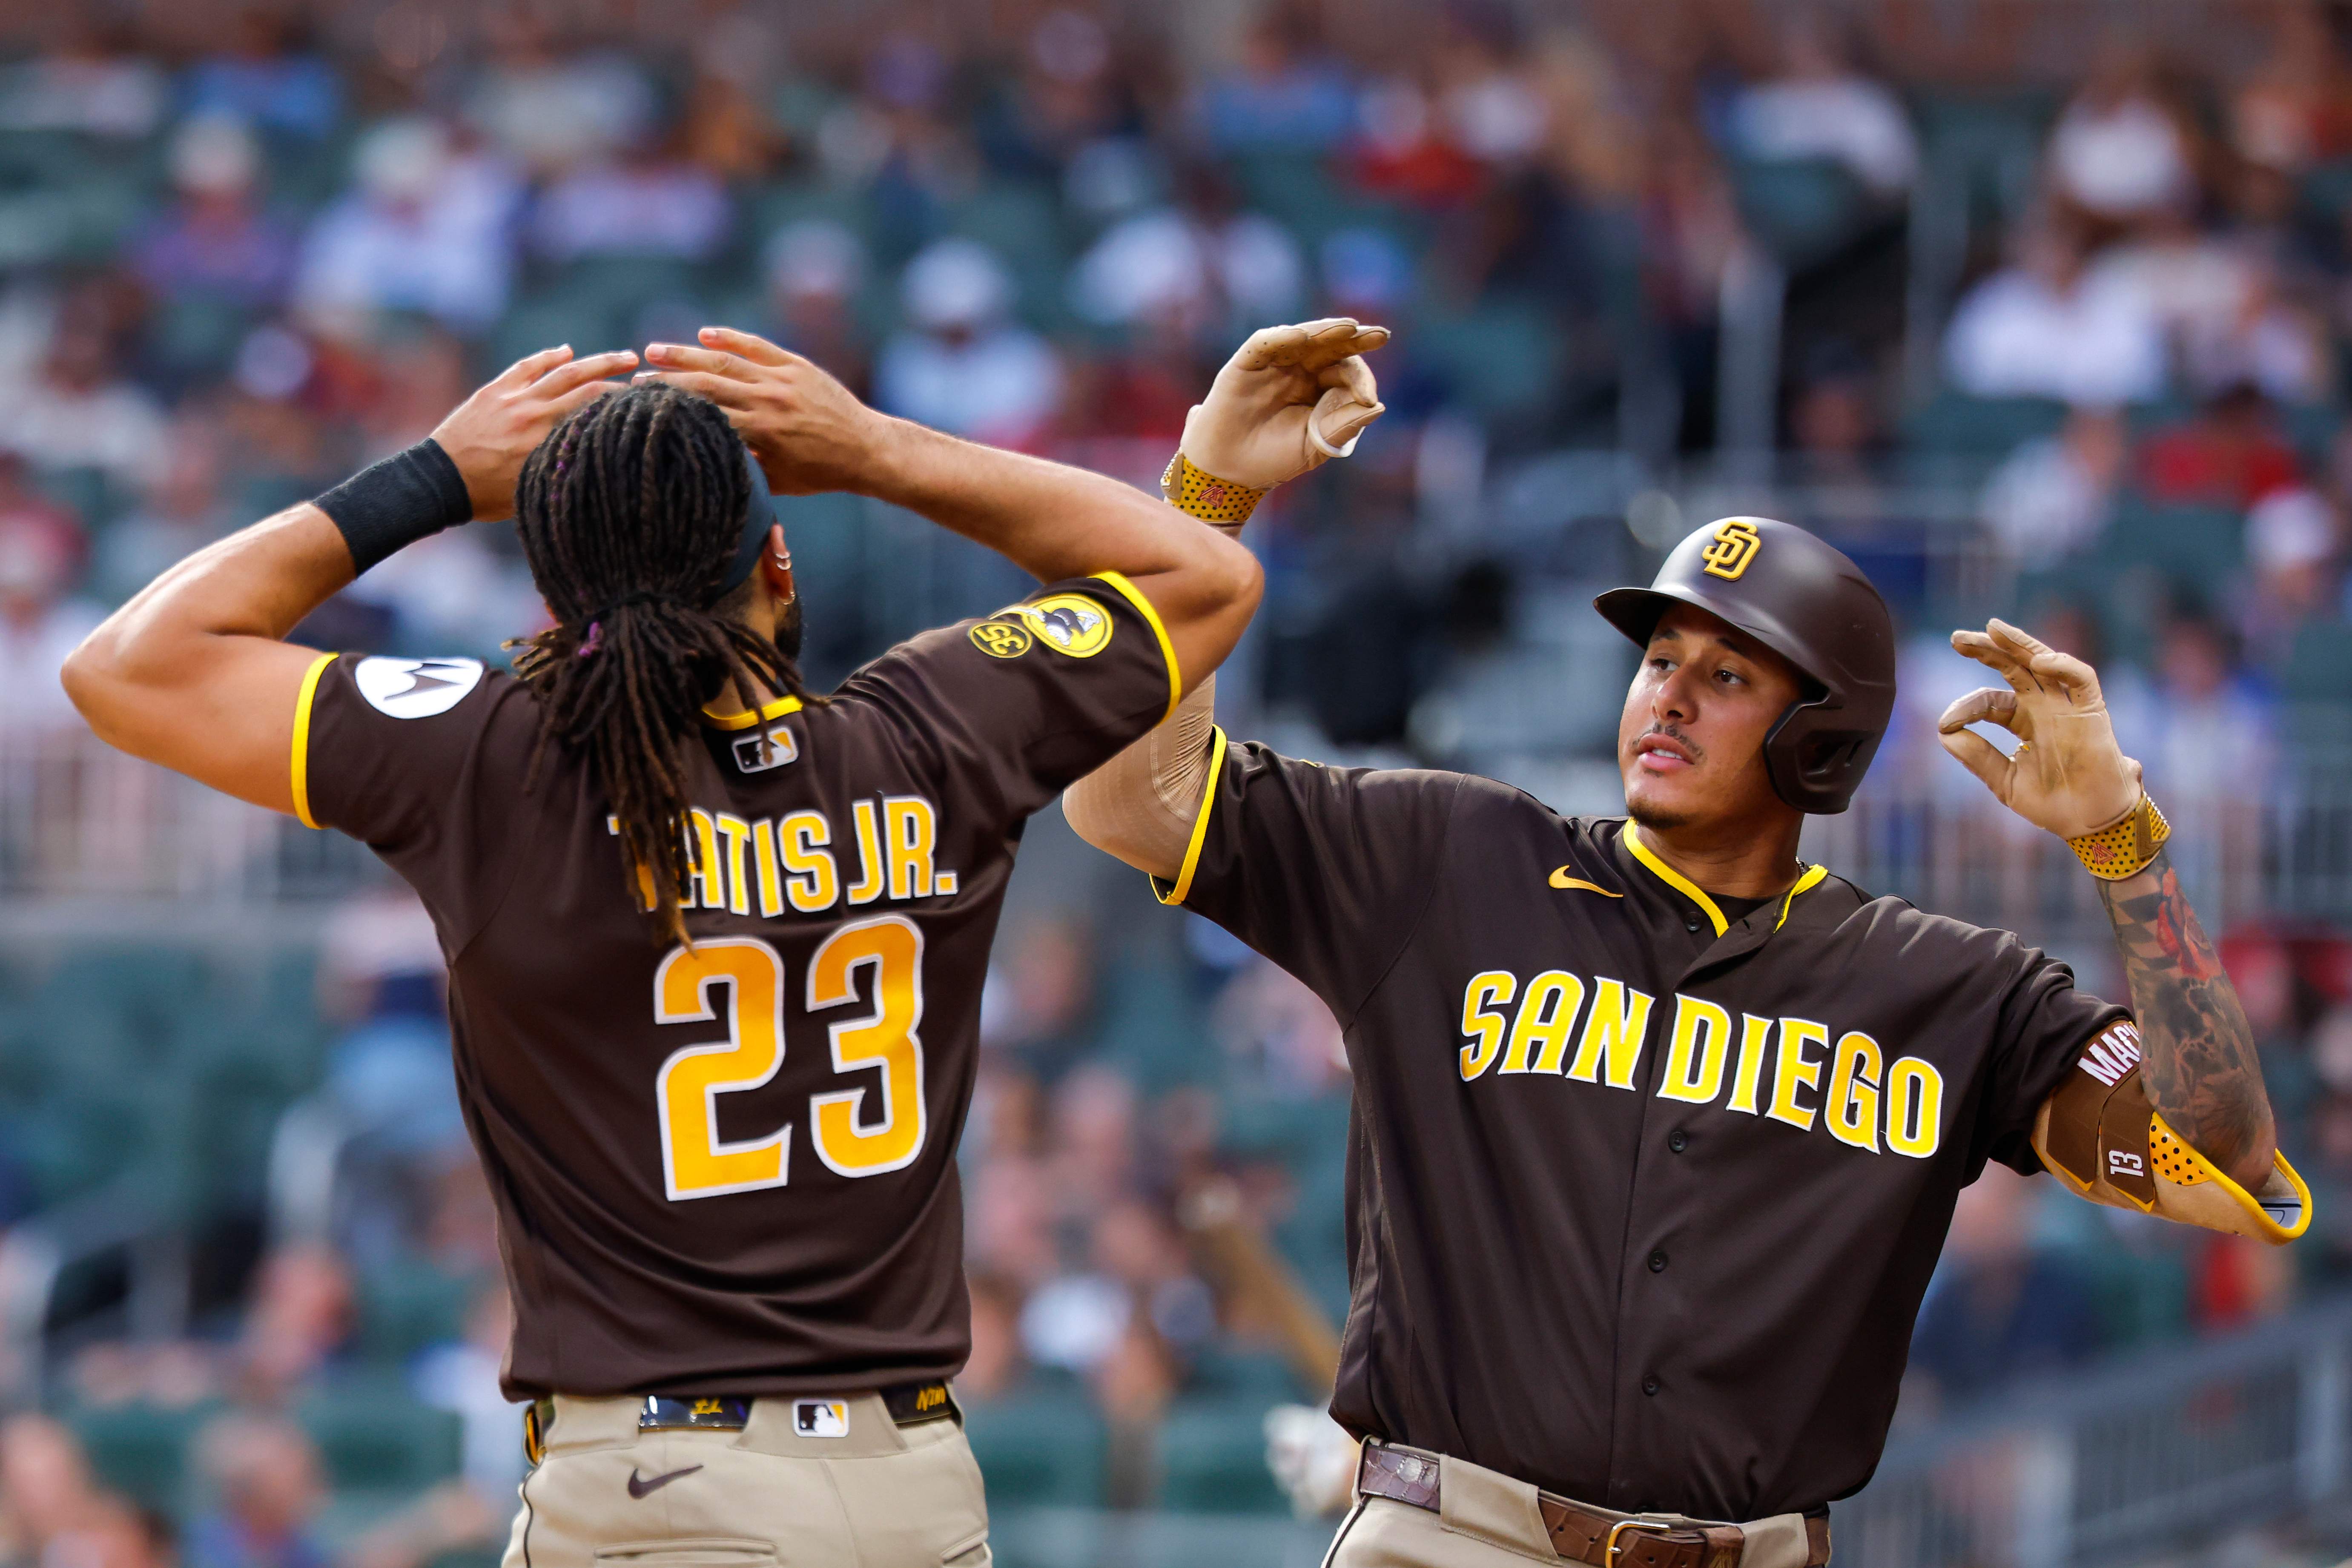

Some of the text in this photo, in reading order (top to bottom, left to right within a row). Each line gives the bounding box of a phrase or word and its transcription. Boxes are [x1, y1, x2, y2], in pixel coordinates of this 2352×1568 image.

[1702, 521, 1761, 581] SD
[975, 625, 1024, 654] 35
[848, 795, 958, 905] JR.
[654, 914, 926, 1201] 23
[1460, 969, 1944, 1159] SAN DIEGO
[2108, 1149, 2145, 1177] 13
